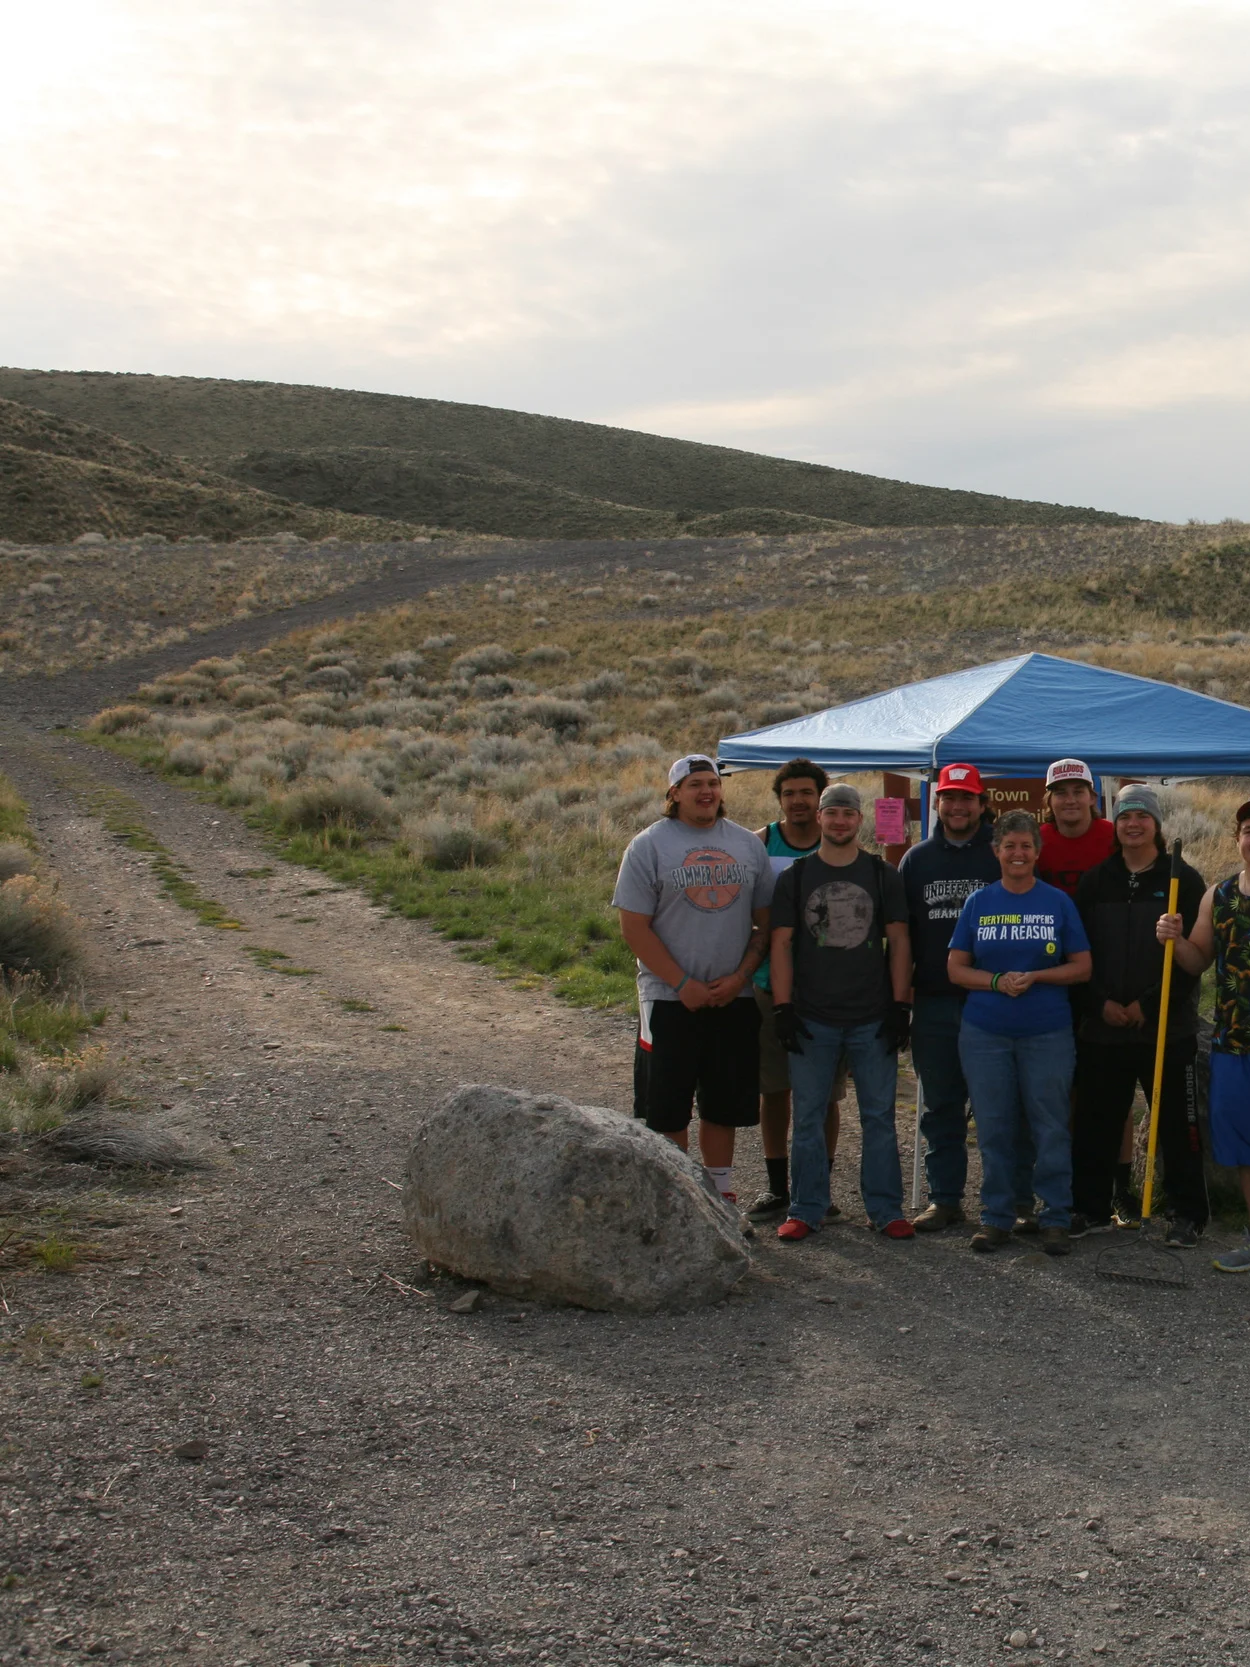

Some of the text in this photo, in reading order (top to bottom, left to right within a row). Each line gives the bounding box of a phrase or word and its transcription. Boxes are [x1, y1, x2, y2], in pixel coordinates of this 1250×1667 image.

[987, 788, 1029, 802] Town
[671, 863, 749, 891] SUMMER CLASSIC
[924, 883, 990, 900] UNDEFEATE
[979, 914, 1055, 927] EVERYTHING HAPPENS
[977, 925, 1057, 942] FOR A REASON.
[1186, 1064, 1196, 1122] BULLDOGS
